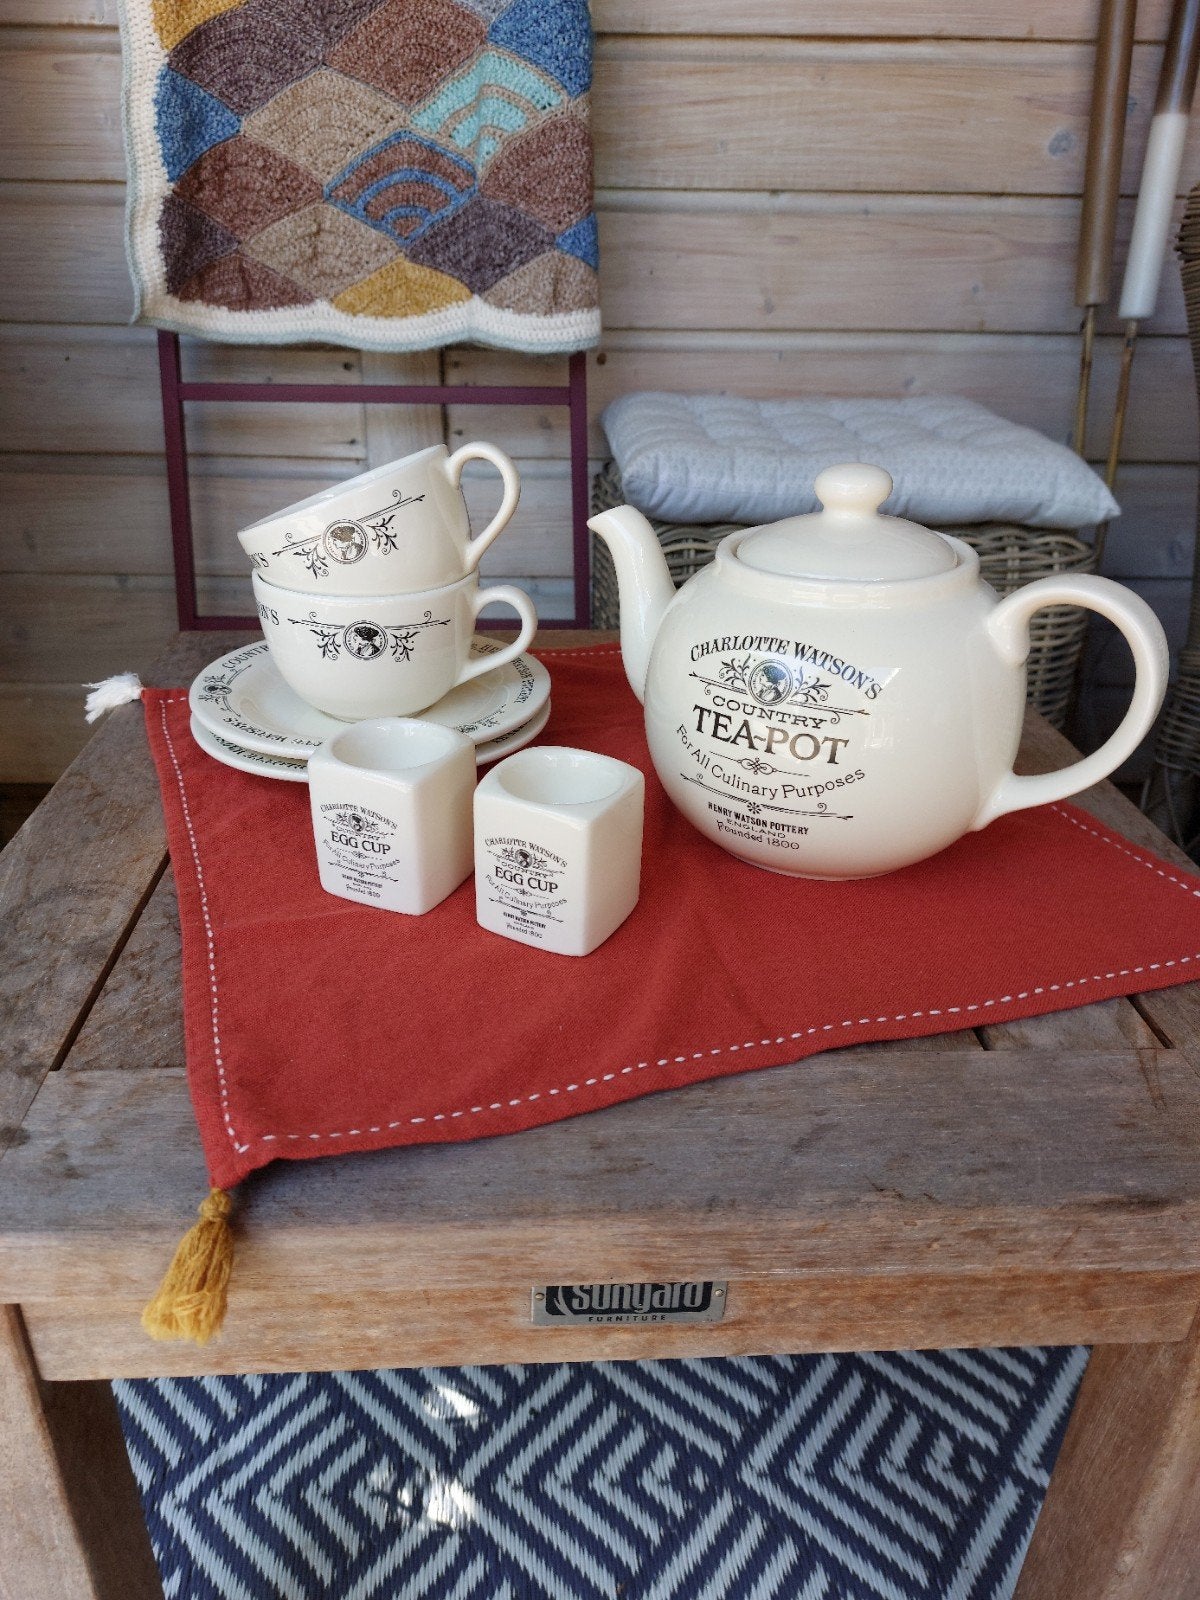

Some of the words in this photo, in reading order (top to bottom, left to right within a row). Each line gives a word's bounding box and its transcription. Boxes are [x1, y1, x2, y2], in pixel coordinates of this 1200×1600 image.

[689, 635, 790, 662] CHARLOTTE
[794, 641, 884, 700] WATSON'S
[712, 695, 828, 729] COUNTRY
[692, 704, 850, 765] TEA-POT
[675, 723, 693, 750] For
[691, 748, 711, 770] All
[711, 764, 779, 800] Culinary
[781, 768, 866, 799] Purposes
[708, 801, 732, 818] HENRY
[733, 811, 768, 828] WATSON
[769, 821, 809, 835] POTTERY
[726, 818, 786, 839] ENGLAND
[330, 830, 359, 849] EGG
[361, 840, 391, 855] CUP
[716, 820, 763, 843] Founded
[767, 837, 800, 850] 1800
[529, 842, 567, 868] WATSON'S
[494, 865, 524, 886] EGG
[527, 877, 559, 894] CUP
